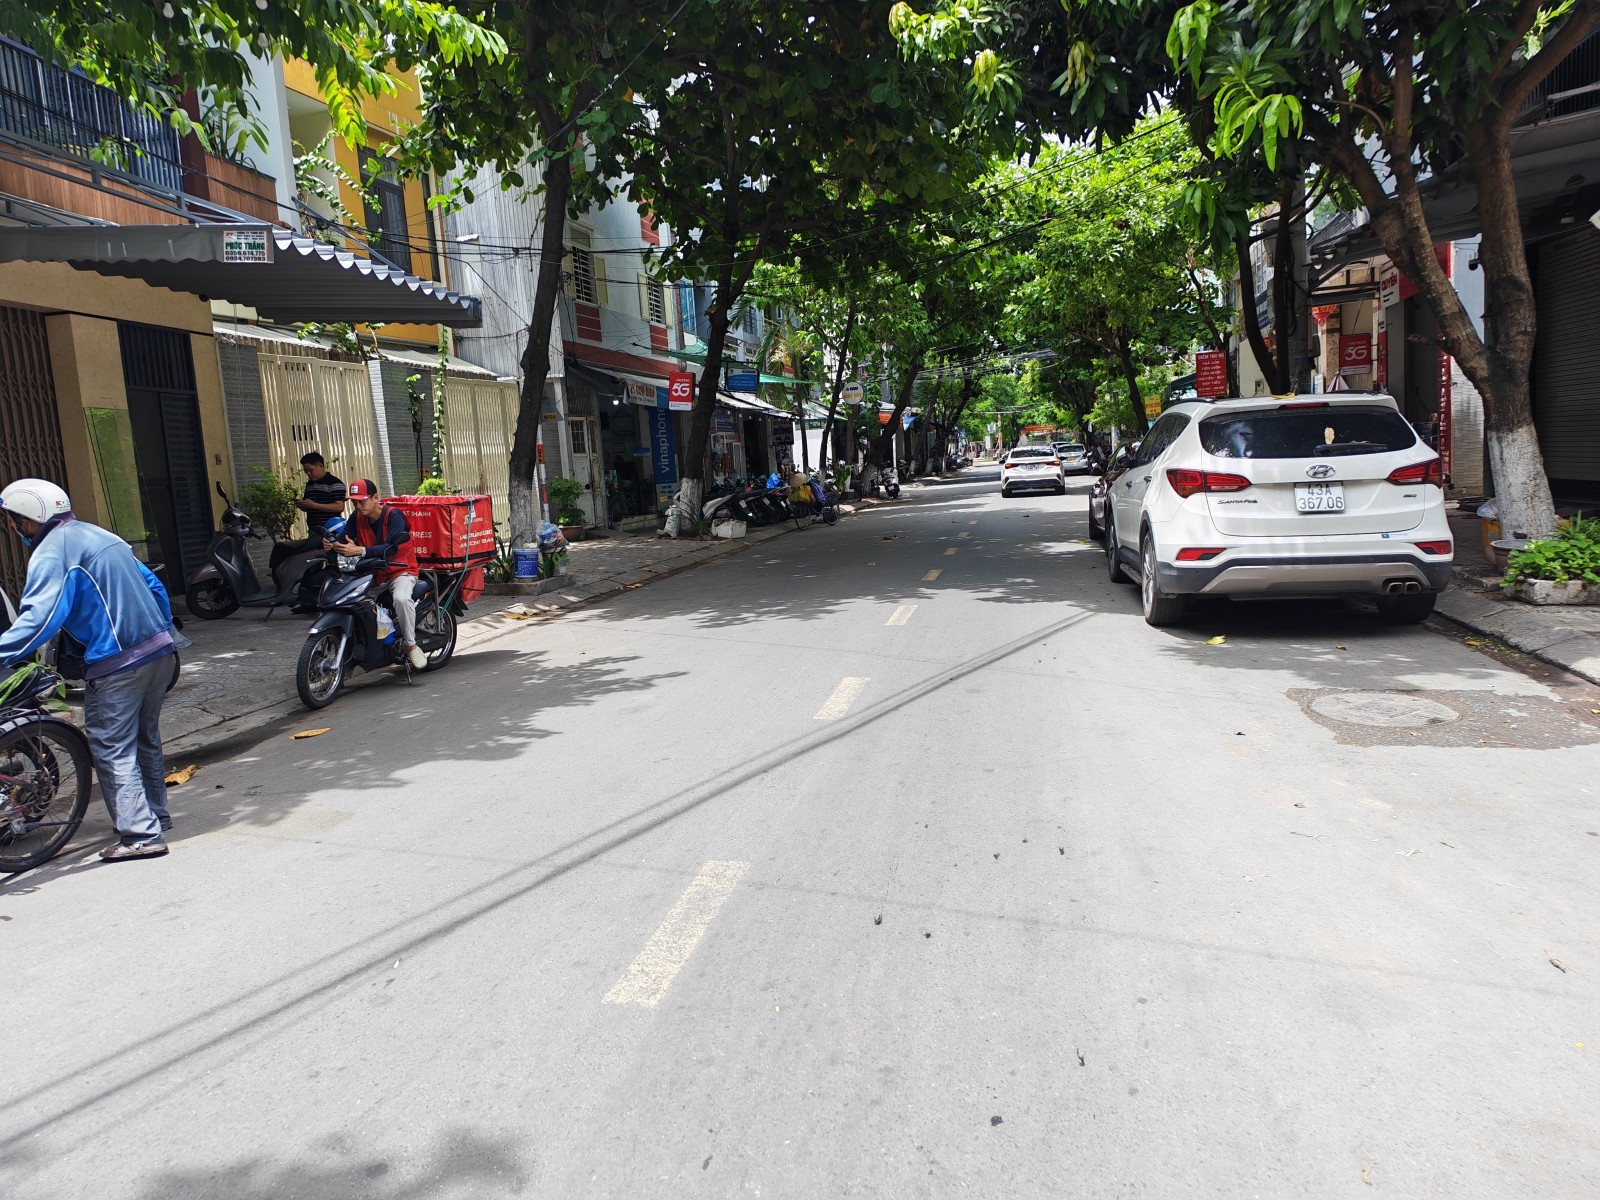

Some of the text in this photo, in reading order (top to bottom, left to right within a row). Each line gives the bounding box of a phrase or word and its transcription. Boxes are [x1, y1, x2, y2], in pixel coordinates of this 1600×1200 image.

[1344, 346, 1368, 360] 5G
[672, 383, 690, 396] 5G
[656, 407, 670, 474] vinaphone
[1307, 483, 1332, 496] 43A
[1299, 497, 1344, 510] 367.06
